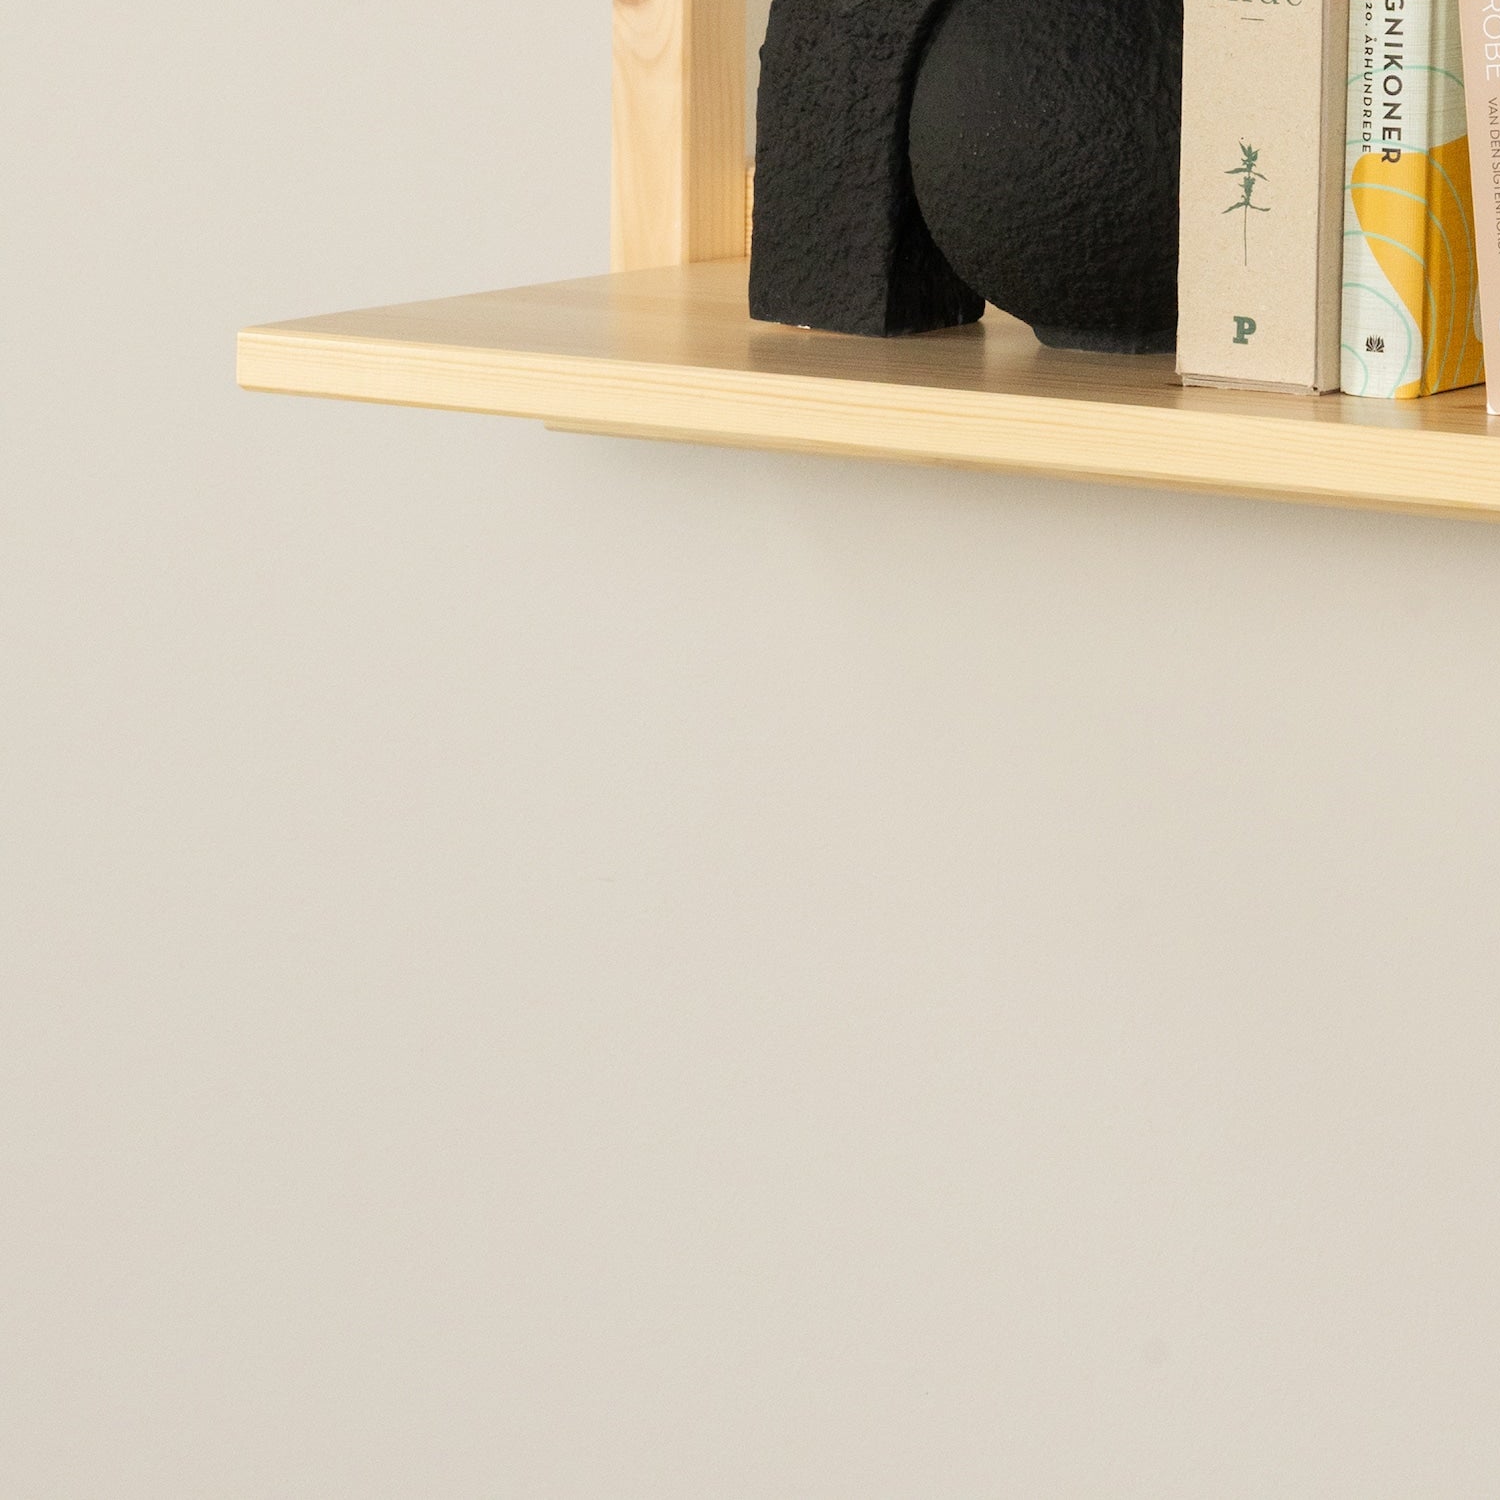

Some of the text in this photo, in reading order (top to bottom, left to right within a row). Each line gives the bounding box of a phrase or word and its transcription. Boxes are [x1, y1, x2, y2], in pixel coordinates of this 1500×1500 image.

[1364, 2, 1373, 27] 20.
[1362, 34, 1377, 153] ÅRHUNDREDE
[1487, 97, 1500, 126] VAN
[1489, 129, 1500, 158] DEN
[1232, 315, 1257, 345] P
